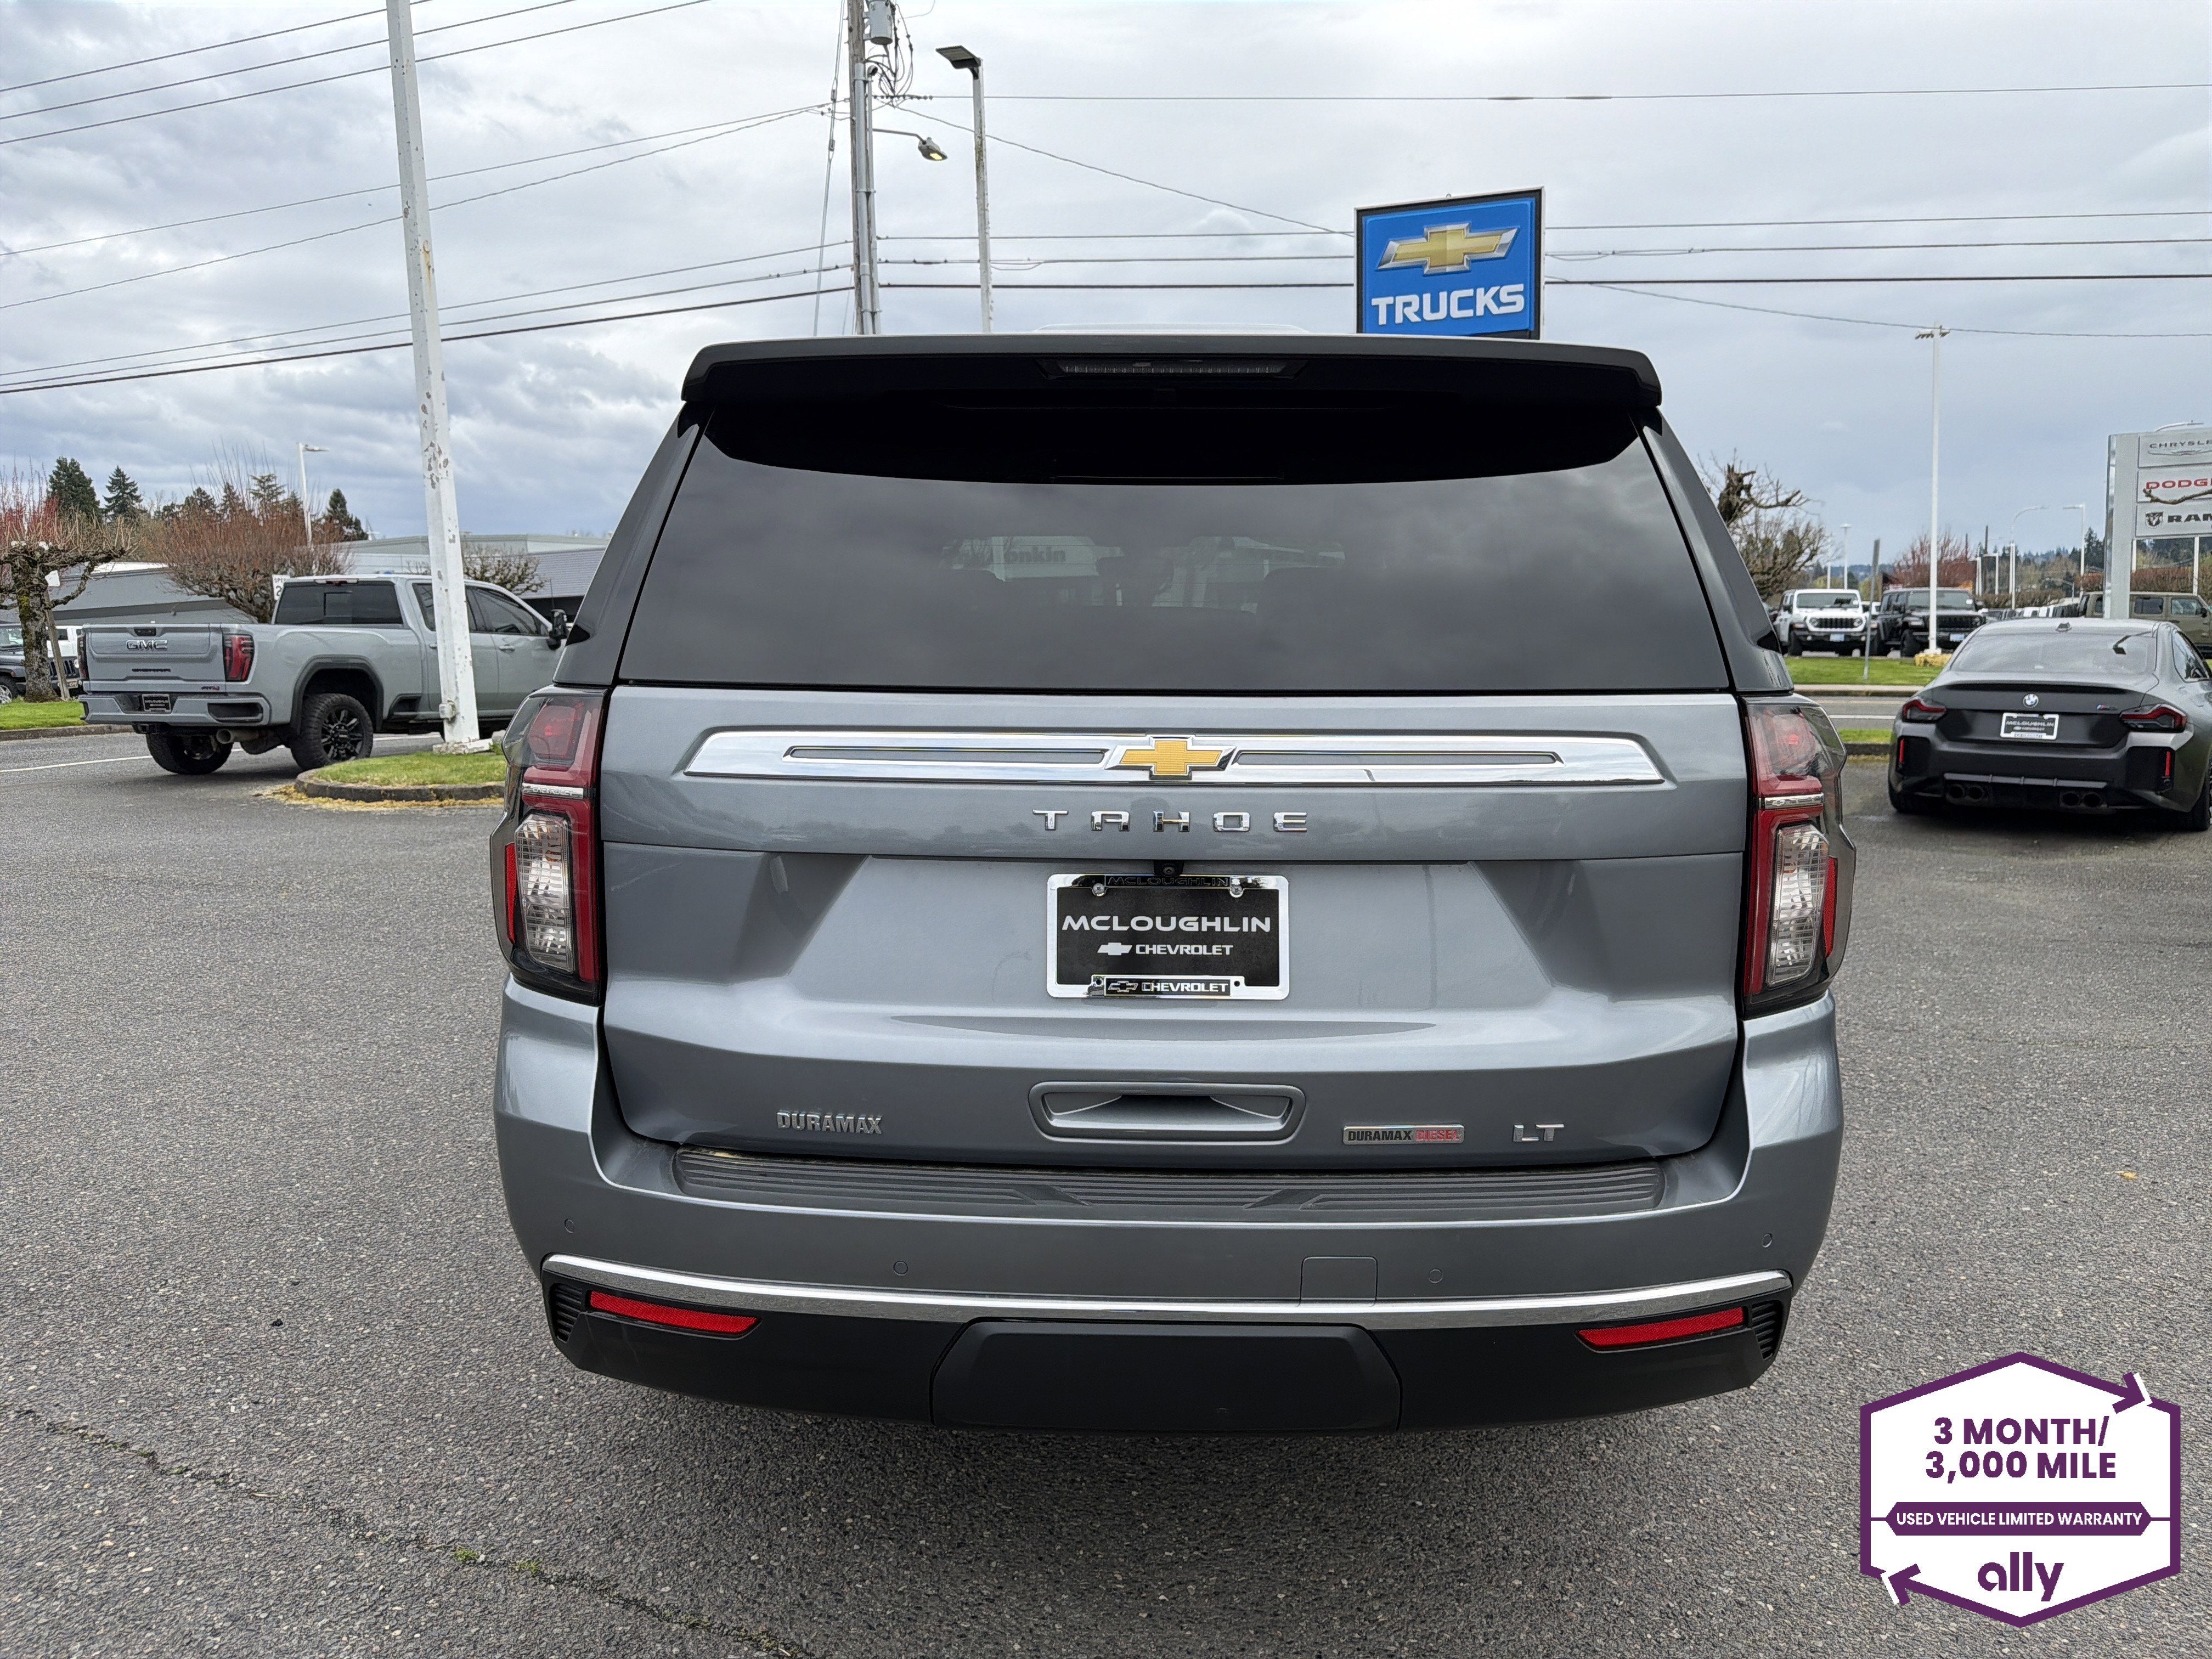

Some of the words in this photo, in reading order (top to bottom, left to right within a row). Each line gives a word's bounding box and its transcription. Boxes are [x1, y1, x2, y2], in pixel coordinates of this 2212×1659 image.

[1372, 284, 1524, 325] TRUCKS
[2149, 440, 2212, 448] CHRYSLE
[126, 640, 167, 651] GMC
[1032, 810, 1307, 832] TAHOE
[1108, 877, 1228, 887] MCLOUGHLIN
[1062, 915, 1271, 933] MCLOUGHLIN
[1136, 944, 1233, 955] CHEVROLET
[1142, 982, 1228, 992] CHEVROLET
[777, 1110, 882, 1135] DURAMAX
[1347, 1129, 1413, 1141] DURAMAX
[1415, 1129, 1459, 1141] DIESEL
[1513, 1124, 1565, 1142] LT
